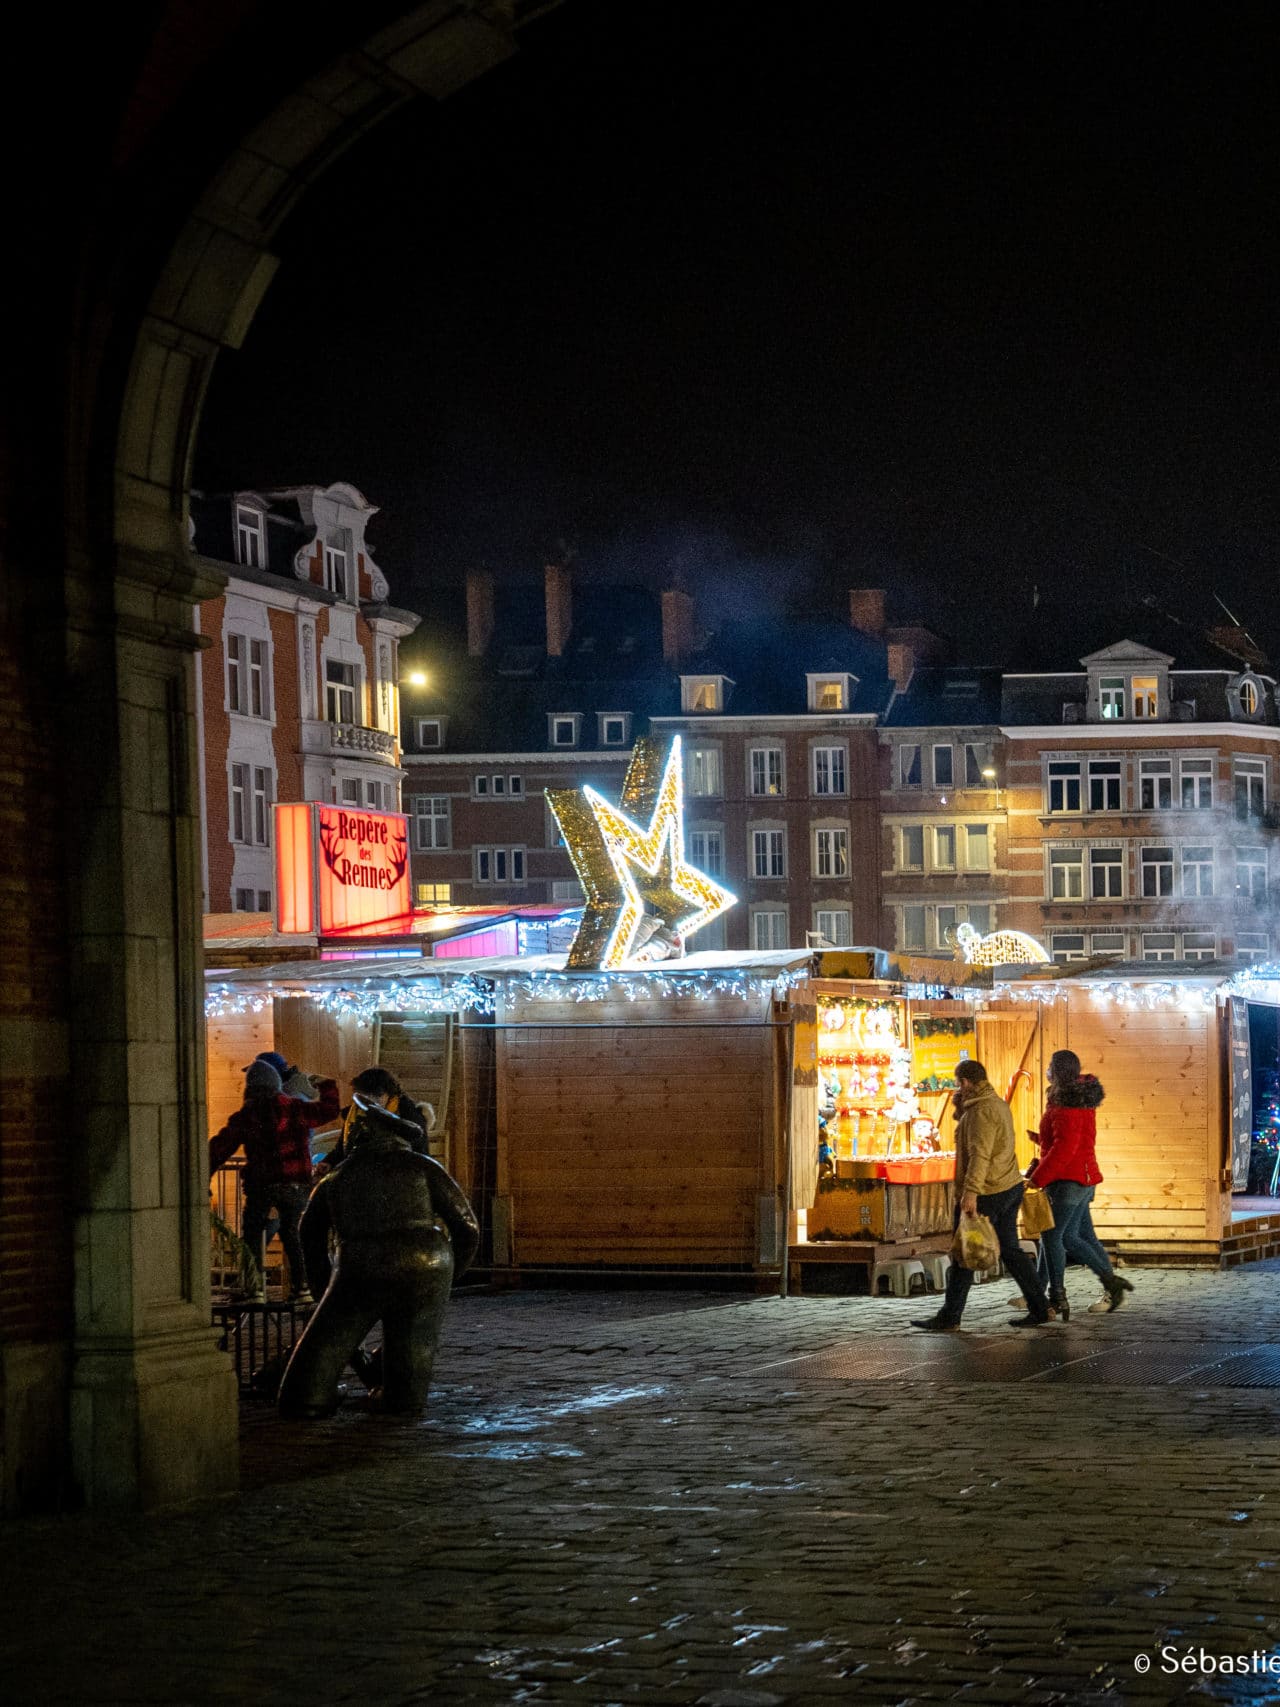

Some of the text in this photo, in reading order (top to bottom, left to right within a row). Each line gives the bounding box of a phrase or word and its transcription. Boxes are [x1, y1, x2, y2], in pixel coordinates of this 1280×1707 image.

[338, 812, 388, 845] Repère
[360, 848, 371, 860] des
[341, 859, 392, 890] Rennes
